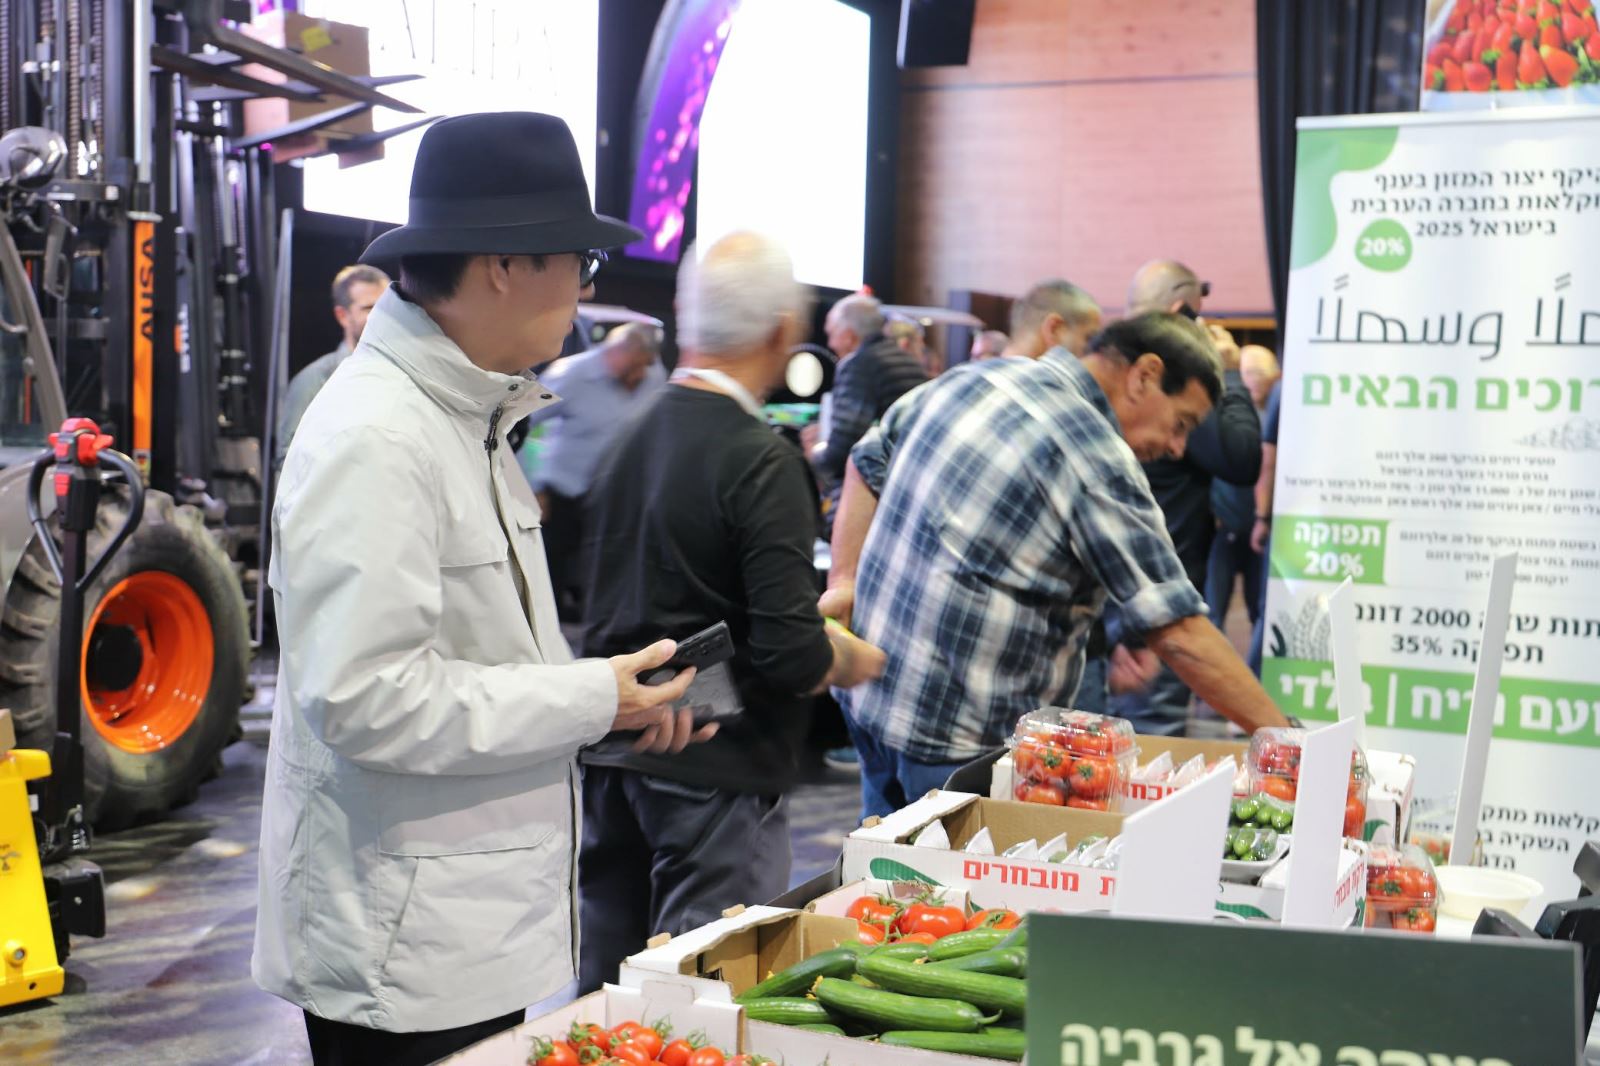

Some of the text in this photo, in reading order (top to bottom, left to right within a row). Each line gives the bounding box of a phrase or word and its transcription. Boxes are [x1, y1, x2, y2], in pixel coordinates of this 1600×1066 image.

[1374, 173, 1426, 193] בענף
[1434, 172, 1493, 191] המזון
[1501, 170, 1544, 186] יצור
[1350, 192, 1600, 214] קלאות בחברה הערבית
[1416, 219, 1557, 237] בישראל 2025
[1361, 237, 1405, 256] 20%
[1301, 373, 1458, 410] הבאים
[1294, 521, 1381, 549] תפוקה
[1304, 551, 1364, 577] 20%
[1411, 606, 1470, 628] 2000
[1391, 635, 1442, 656] 35%
[1534, 811, 1600, 835] קלאות
[1501, 831, 1569, 852] השקיה
[963, 860, 1079, 892] מובחרים
